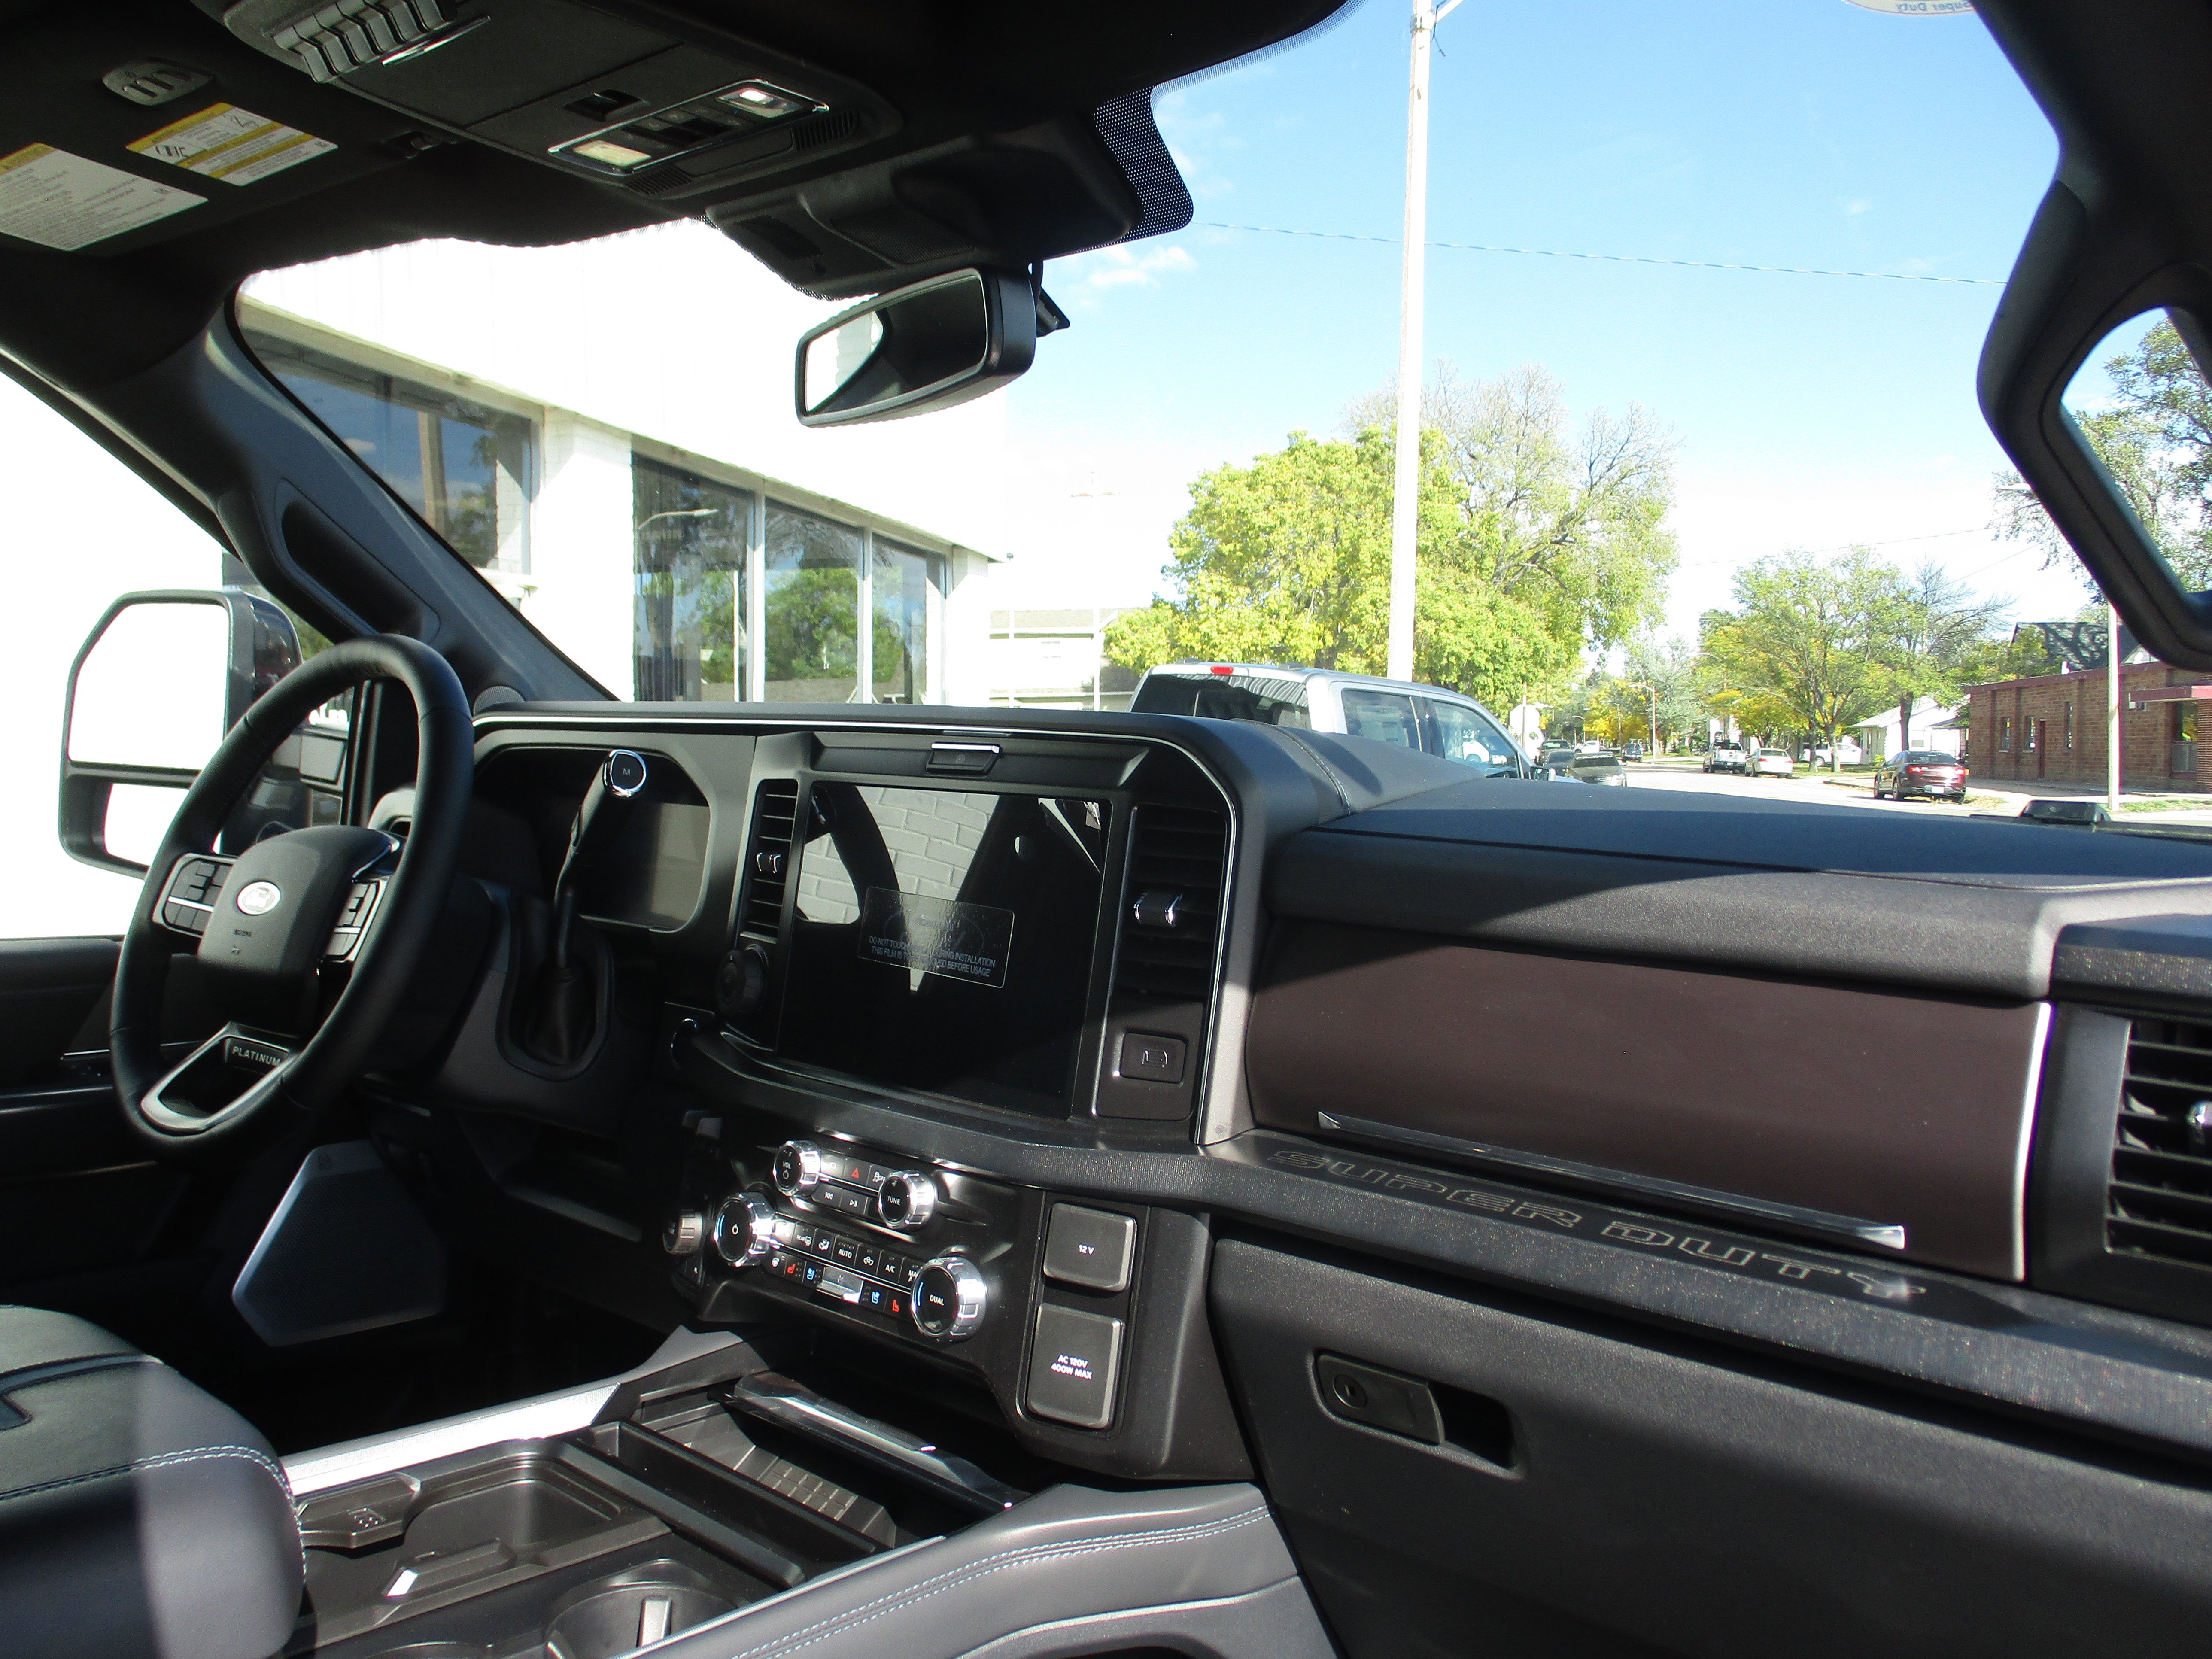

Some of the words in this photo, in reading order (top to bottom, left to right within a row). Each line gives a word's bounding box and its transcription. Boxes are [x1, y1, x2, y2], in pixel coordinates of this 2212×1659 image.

[869, 936, 877, 945] DO
[878, 937, 888, 947] NOT
[954, 952, 996, 968] INSTALLATION
[872, 945, 883, 955] THIS
[883, 948, 897, 958] FILM
[897, 950, 903, 960] IS
[919, 955, 947, 968] REOVED
[947, 961, 970, 973] BEFORE
[970, 965, 991, 977] USAGE
[232, 1045, 280, 1066] PLATINUM
[782, 1161, 793, 1170] VOL
[887, 1196, 901, 1206] TUNE
[1267, 1151, 1583, 1228] SUPER
[1601, 1221, 1927, 1299] DUTY
[837, 1248, 853, 1259] AUTO
[1078, 1244, 1088, 1254] 12
[1088, 1246, 1094, 1255] V
[885, 1264, 896, 1274] A/C
[929, 1293, 945, 1307] DUAL
[1057, 1354, 1069, 1364] AC
[1069, 1357, 1088, 1369] 120V
[1051, 1362, 1074, 1376] 400W
[1074, 1368, 1093, 1380] MAX
